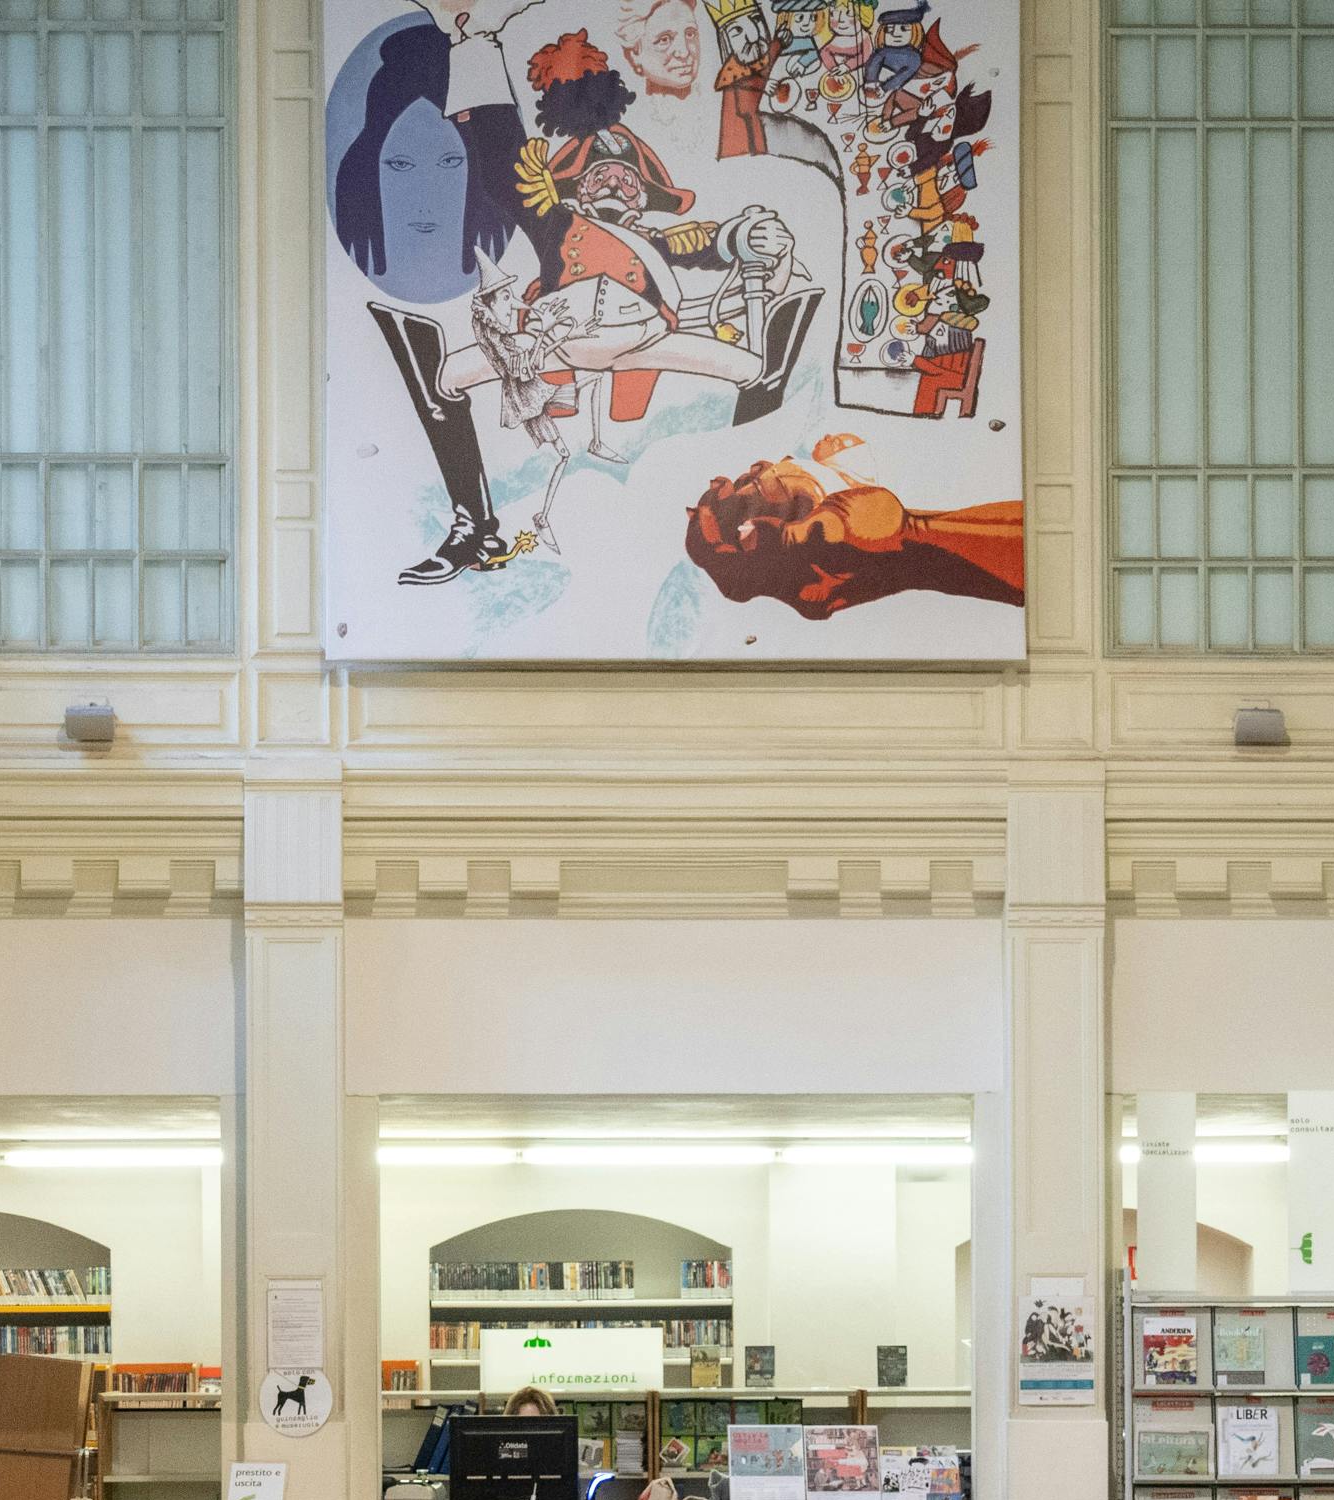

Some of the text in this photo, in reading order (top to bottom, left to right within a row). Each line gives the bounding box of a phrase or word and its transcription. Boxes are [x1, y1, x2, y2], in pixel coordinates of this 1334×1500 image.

[530, 1373, 637, 1384] informazioni
[1236, 1408, 1268, 1420] LIBER
[235, 1469, 272, 1478] prestito
[234, 1478, 262, 1487] uscita
